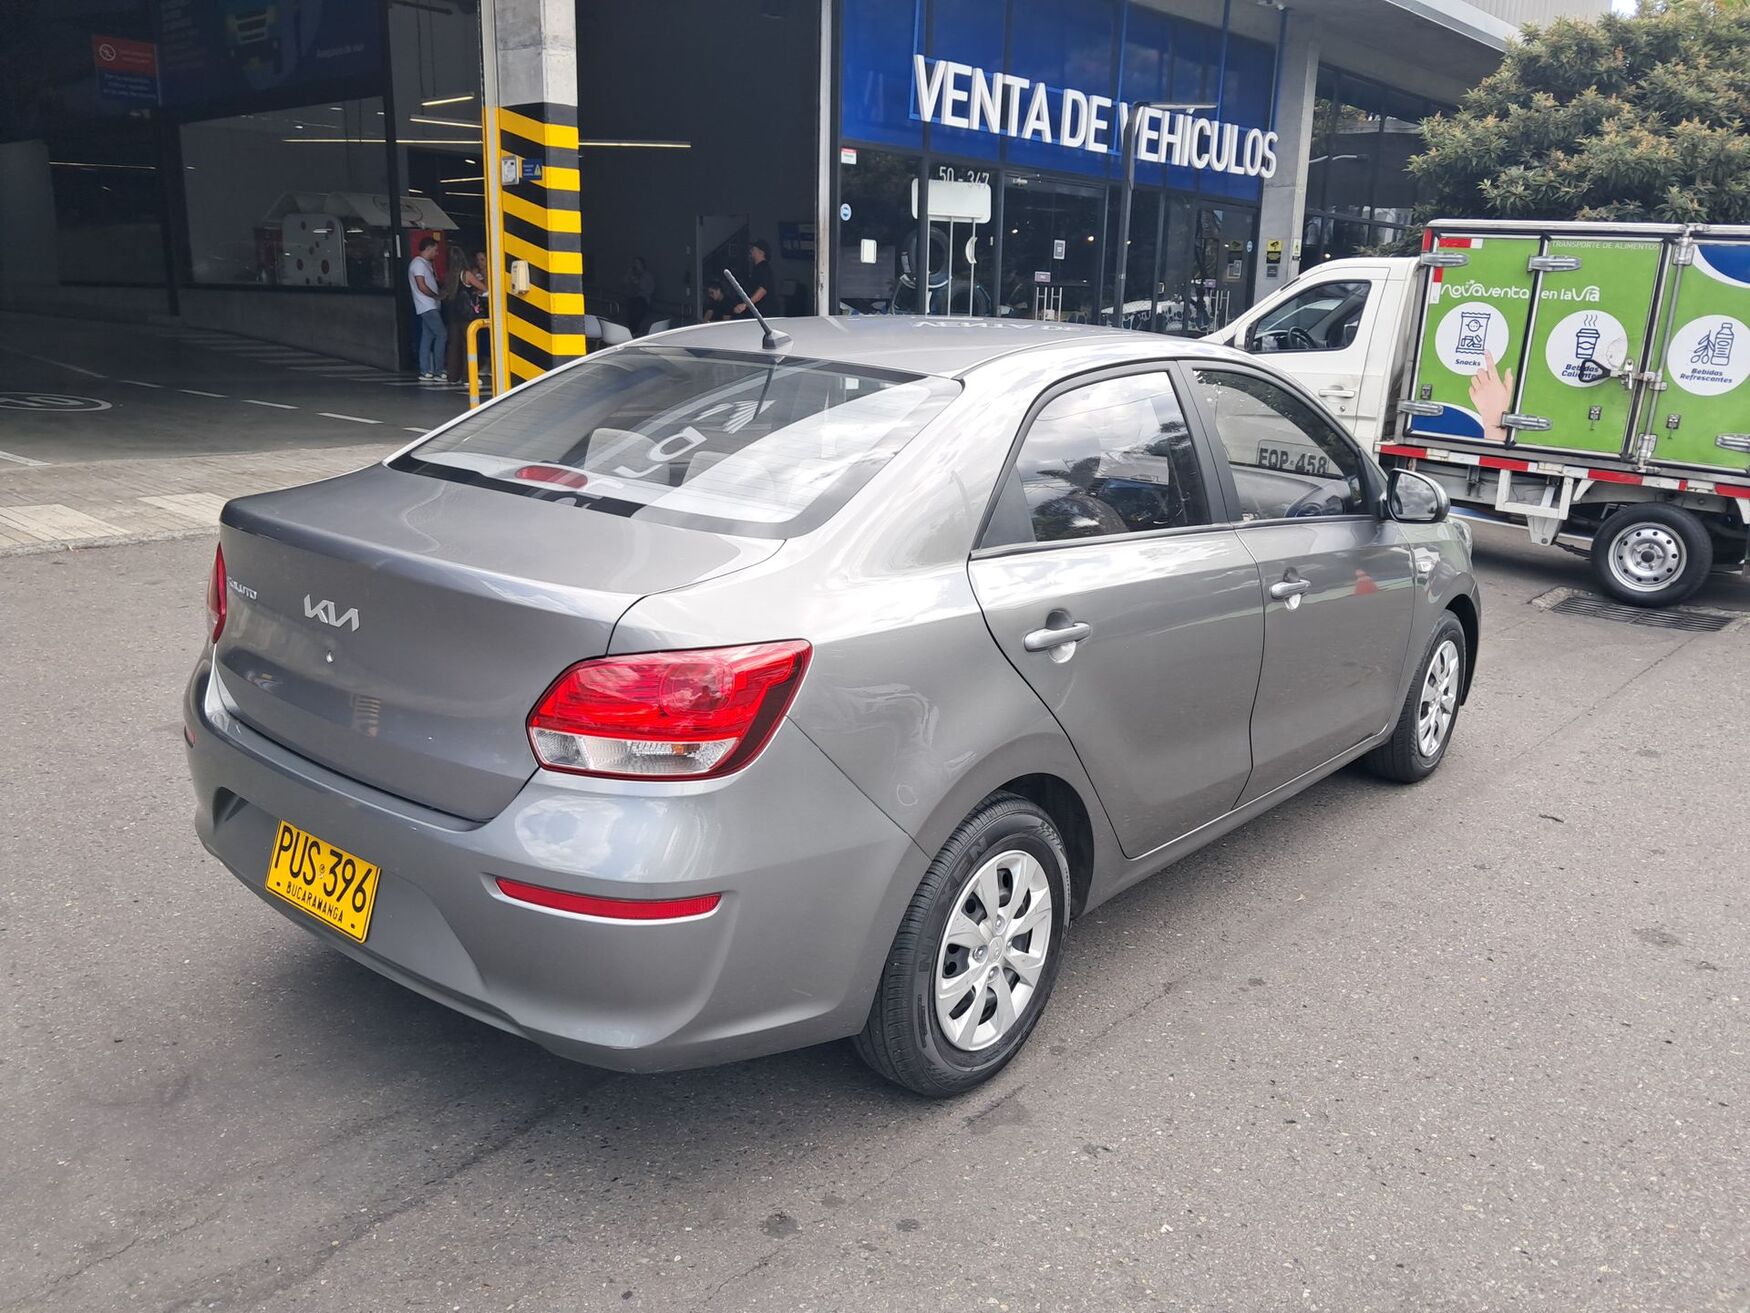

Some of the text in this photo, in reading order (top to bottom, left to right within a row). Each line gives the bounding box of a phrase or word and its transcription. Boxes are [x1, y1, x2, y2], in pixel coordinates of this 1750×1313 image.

[913, 54, 1278, 179] VENTA DE VEHÍCULOS
[939, 166, 955, 182] 50
[1552, 239, 1660, 251] TRANSPORTE DE ALIMENTOS
[1541, 289, 1558, 300] en
[1455, 358, 1481, 367] Snacks
[1565, 363, 1598, 373] Bebdas
[1691, 367, 1723, 377] Bebidas
[1680, 373, 1733, 384] Refrescantes
[303, 594, 360, 631] KIA
[275, 824, 373, 914] PUS 396
[285, 881, 344, 924] BUCARAMANGA
